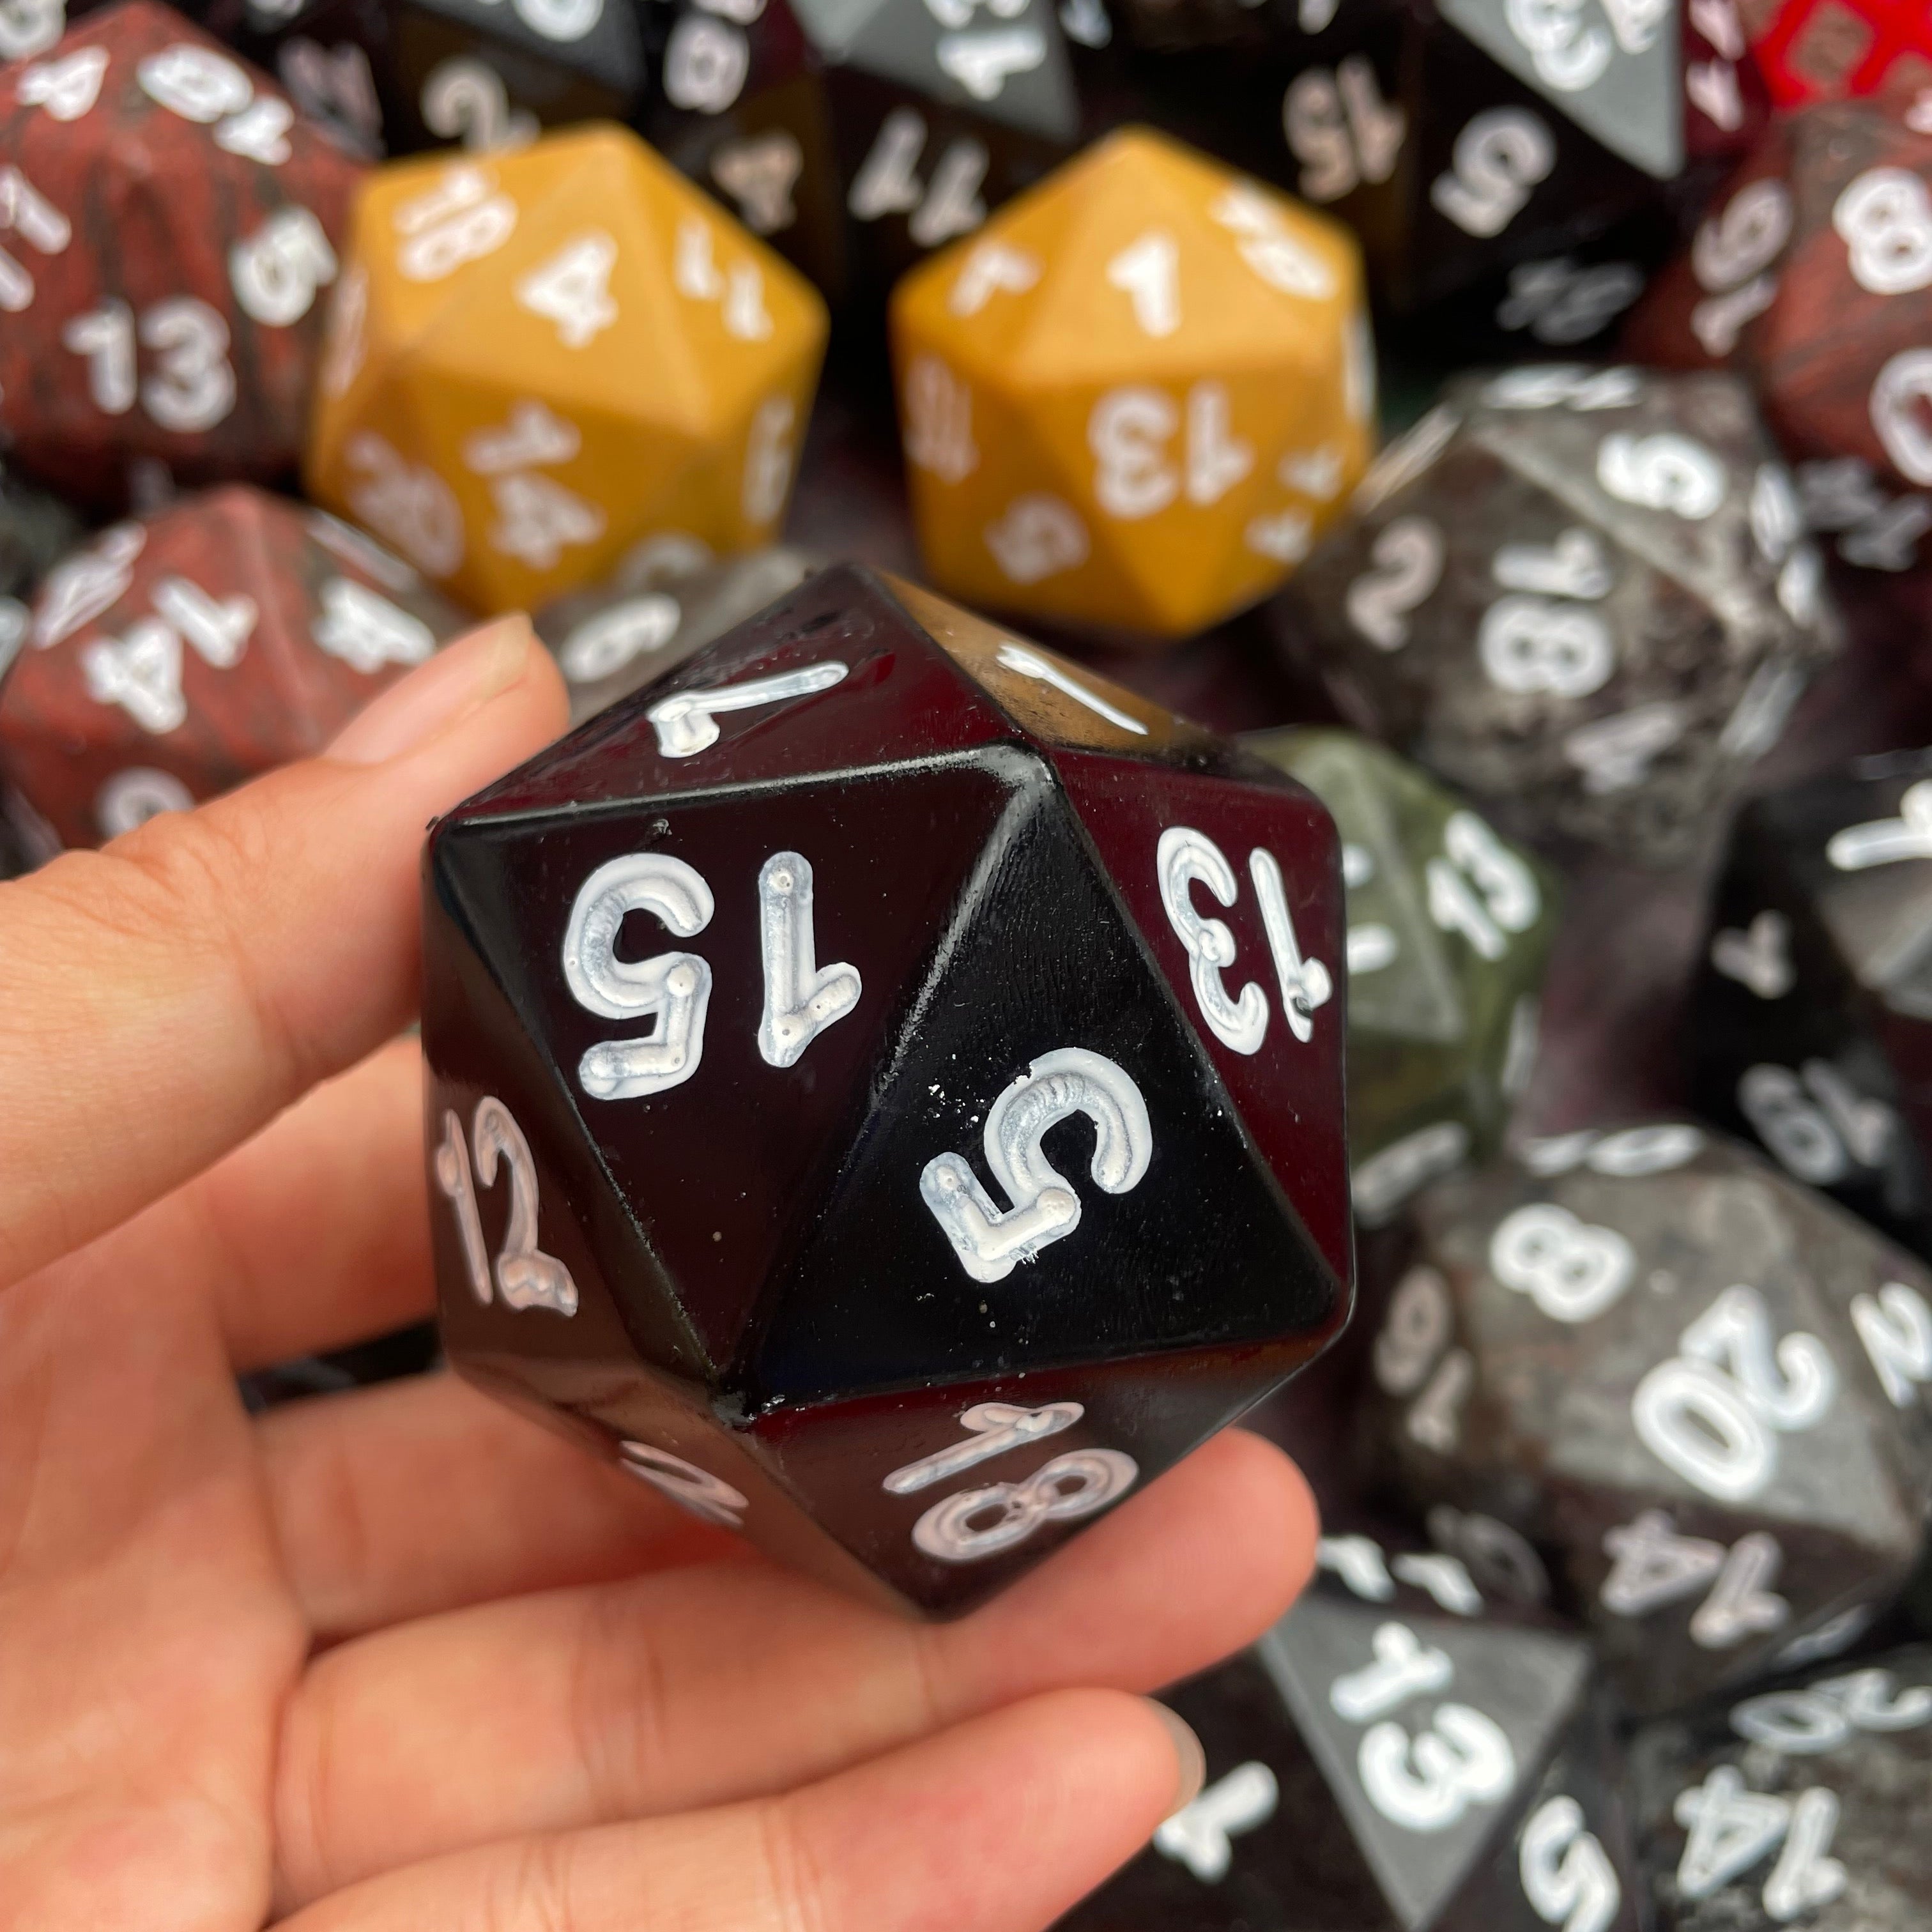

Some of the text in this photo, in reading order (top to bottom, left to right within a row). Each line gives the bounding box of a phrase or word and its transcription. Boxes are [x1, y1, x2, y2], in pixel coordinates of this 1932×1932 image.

[516, 230, 618, 348] 4
[1105, 230, 1182, 339] 1
[1832, 167, 1932, 296] 8
[63, 297, 236, 431] 13
[1087, 382, 1254, 519] 13
[80, 574, 259, 735] 14
[1479, 527, 1618, 700] 18
[560, 851, 864, 1101] 15
[1155, 825, 1334, 1057] 13
[437, 1096, 580, 1319] 12
[919, 1046, 1154, 1284] 5
[1491, 1202, 1636, 1324] 8
[1631, 1283, 1839, 1501] 20
[883, 1400, 1140, 1563] 18
[1598, 1509, 1790, 1648] 14
[1330, 1621, 1515, 1832] 13
[1673, 1762, 1850, 1919] 14
